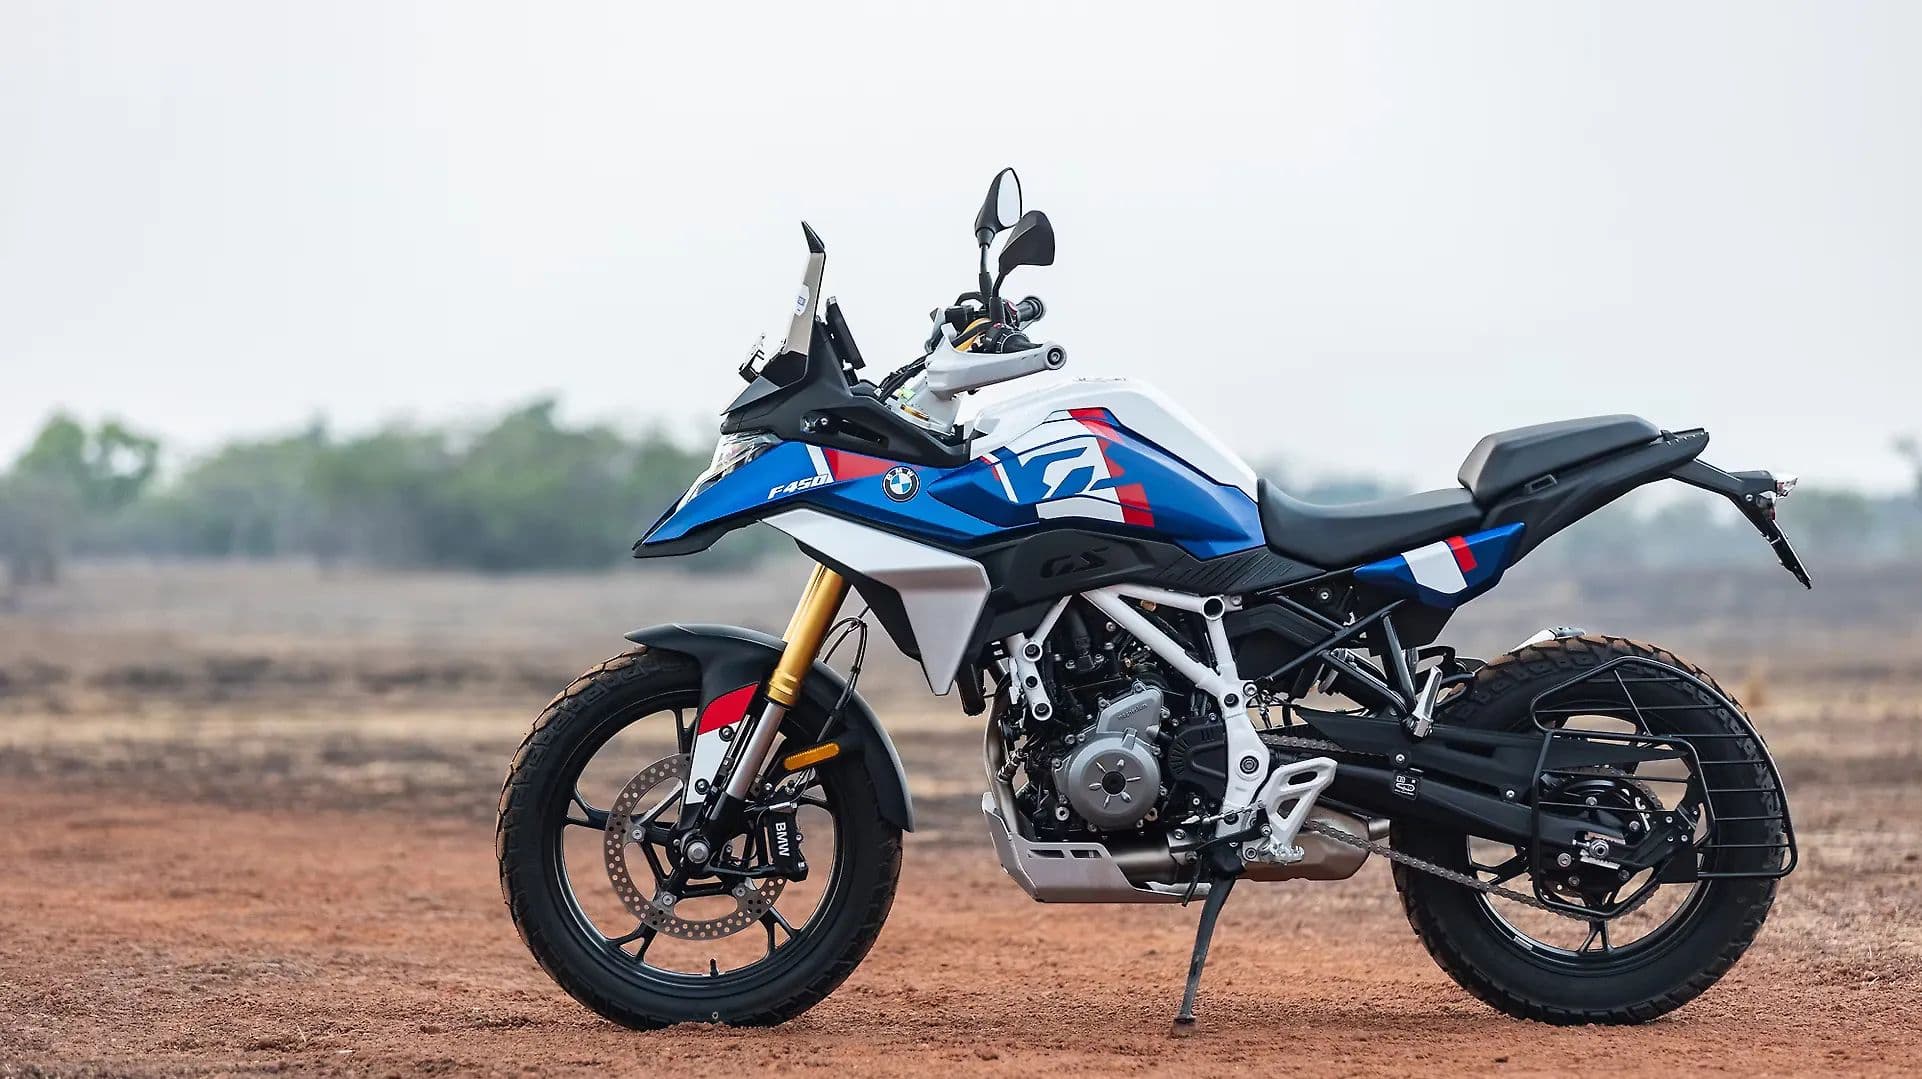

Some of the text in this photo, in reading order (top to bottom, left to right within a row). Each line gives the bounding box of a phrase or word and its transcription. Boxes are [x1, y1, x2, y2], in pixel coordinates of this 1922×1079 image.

[767, 474, 829, 500] F450
[885, 467, 915, 481] BMW
[1040, 546, 1109, 578] GS
[775, 821, 790, 857] BMW
